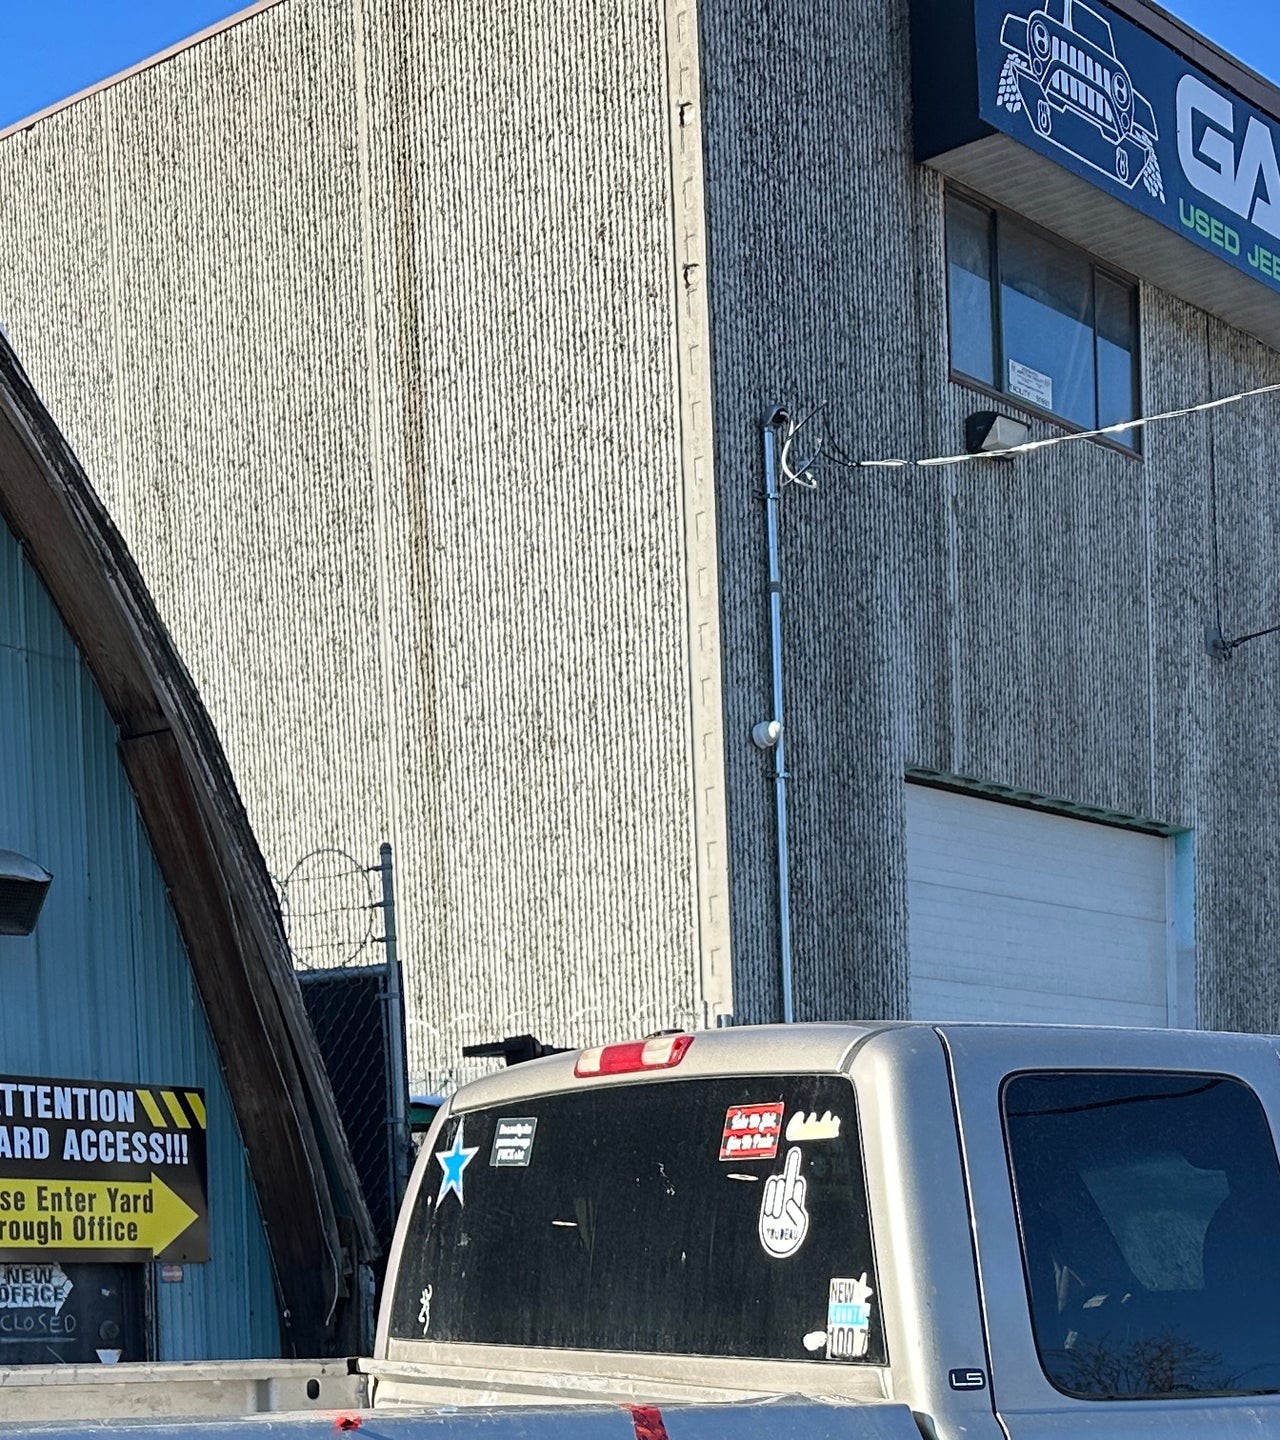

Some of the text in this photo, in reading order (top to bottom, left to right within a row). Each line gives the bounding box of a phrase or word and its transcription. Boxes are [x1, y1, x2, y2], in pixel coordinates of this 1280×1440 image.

[1179, 198, 1240, 255] USED
[62, 1129, 189, 1165] ACCESS!!!
[37, 1186, 97, 1213] Enter
[107, 1187, 154, 1214] Yard
[73, 1215, 138, 1241] Office
[4, 1267, 52, 1284] NEW
[830, 1282, 855, 1304] NEW
[0, 1314, 76, 1333] CLOSED
[952, 1373, 983, 1386] LS
